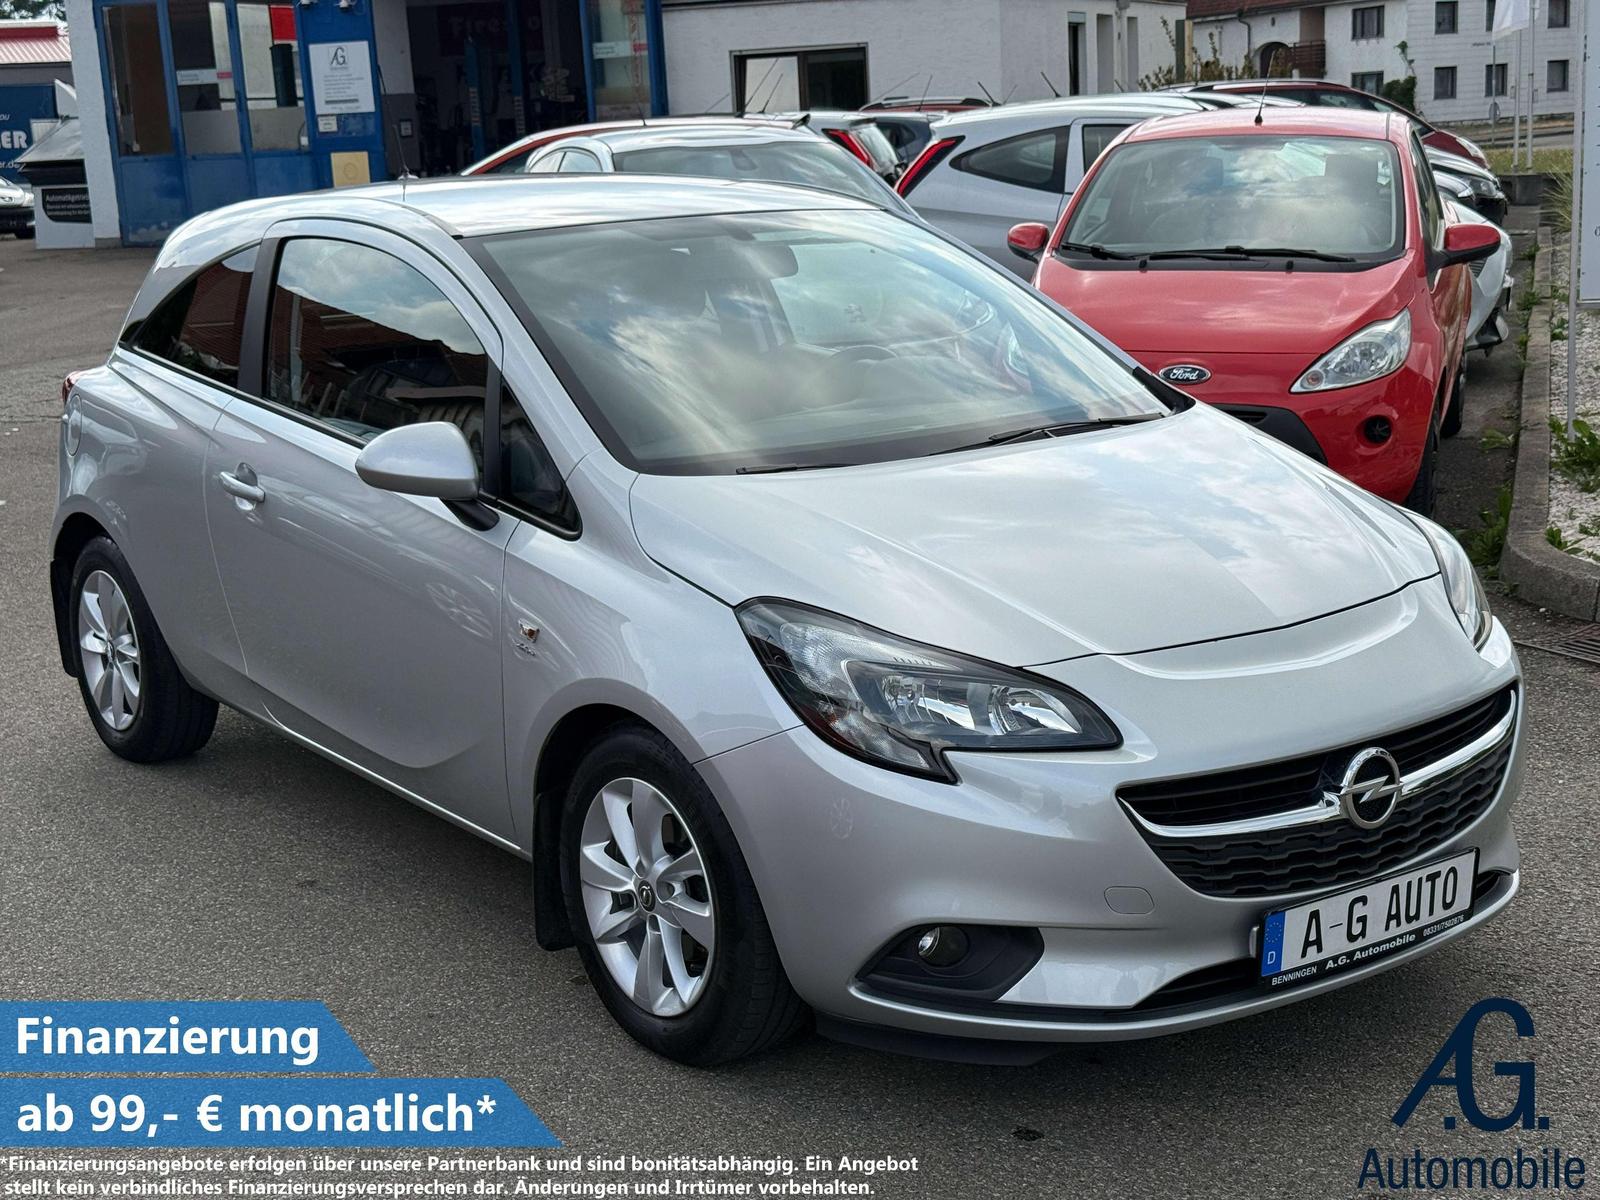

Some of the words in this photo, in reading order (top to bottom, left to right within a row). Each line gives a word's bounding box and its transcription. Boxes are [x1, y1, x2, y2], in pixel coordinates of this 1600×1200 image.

[0, 130, 28, 149] ER
[1169, 367, 1199, 380] Ford
[1267, 951, 1276, 965] D
[1384, 866, 1458, 932] AUTO
[1271, 966, 1318, 986] BENNINGEN
[1325, 957, 1351, 971] A.G.
[1353, 934, 1416, 961] Automobile
